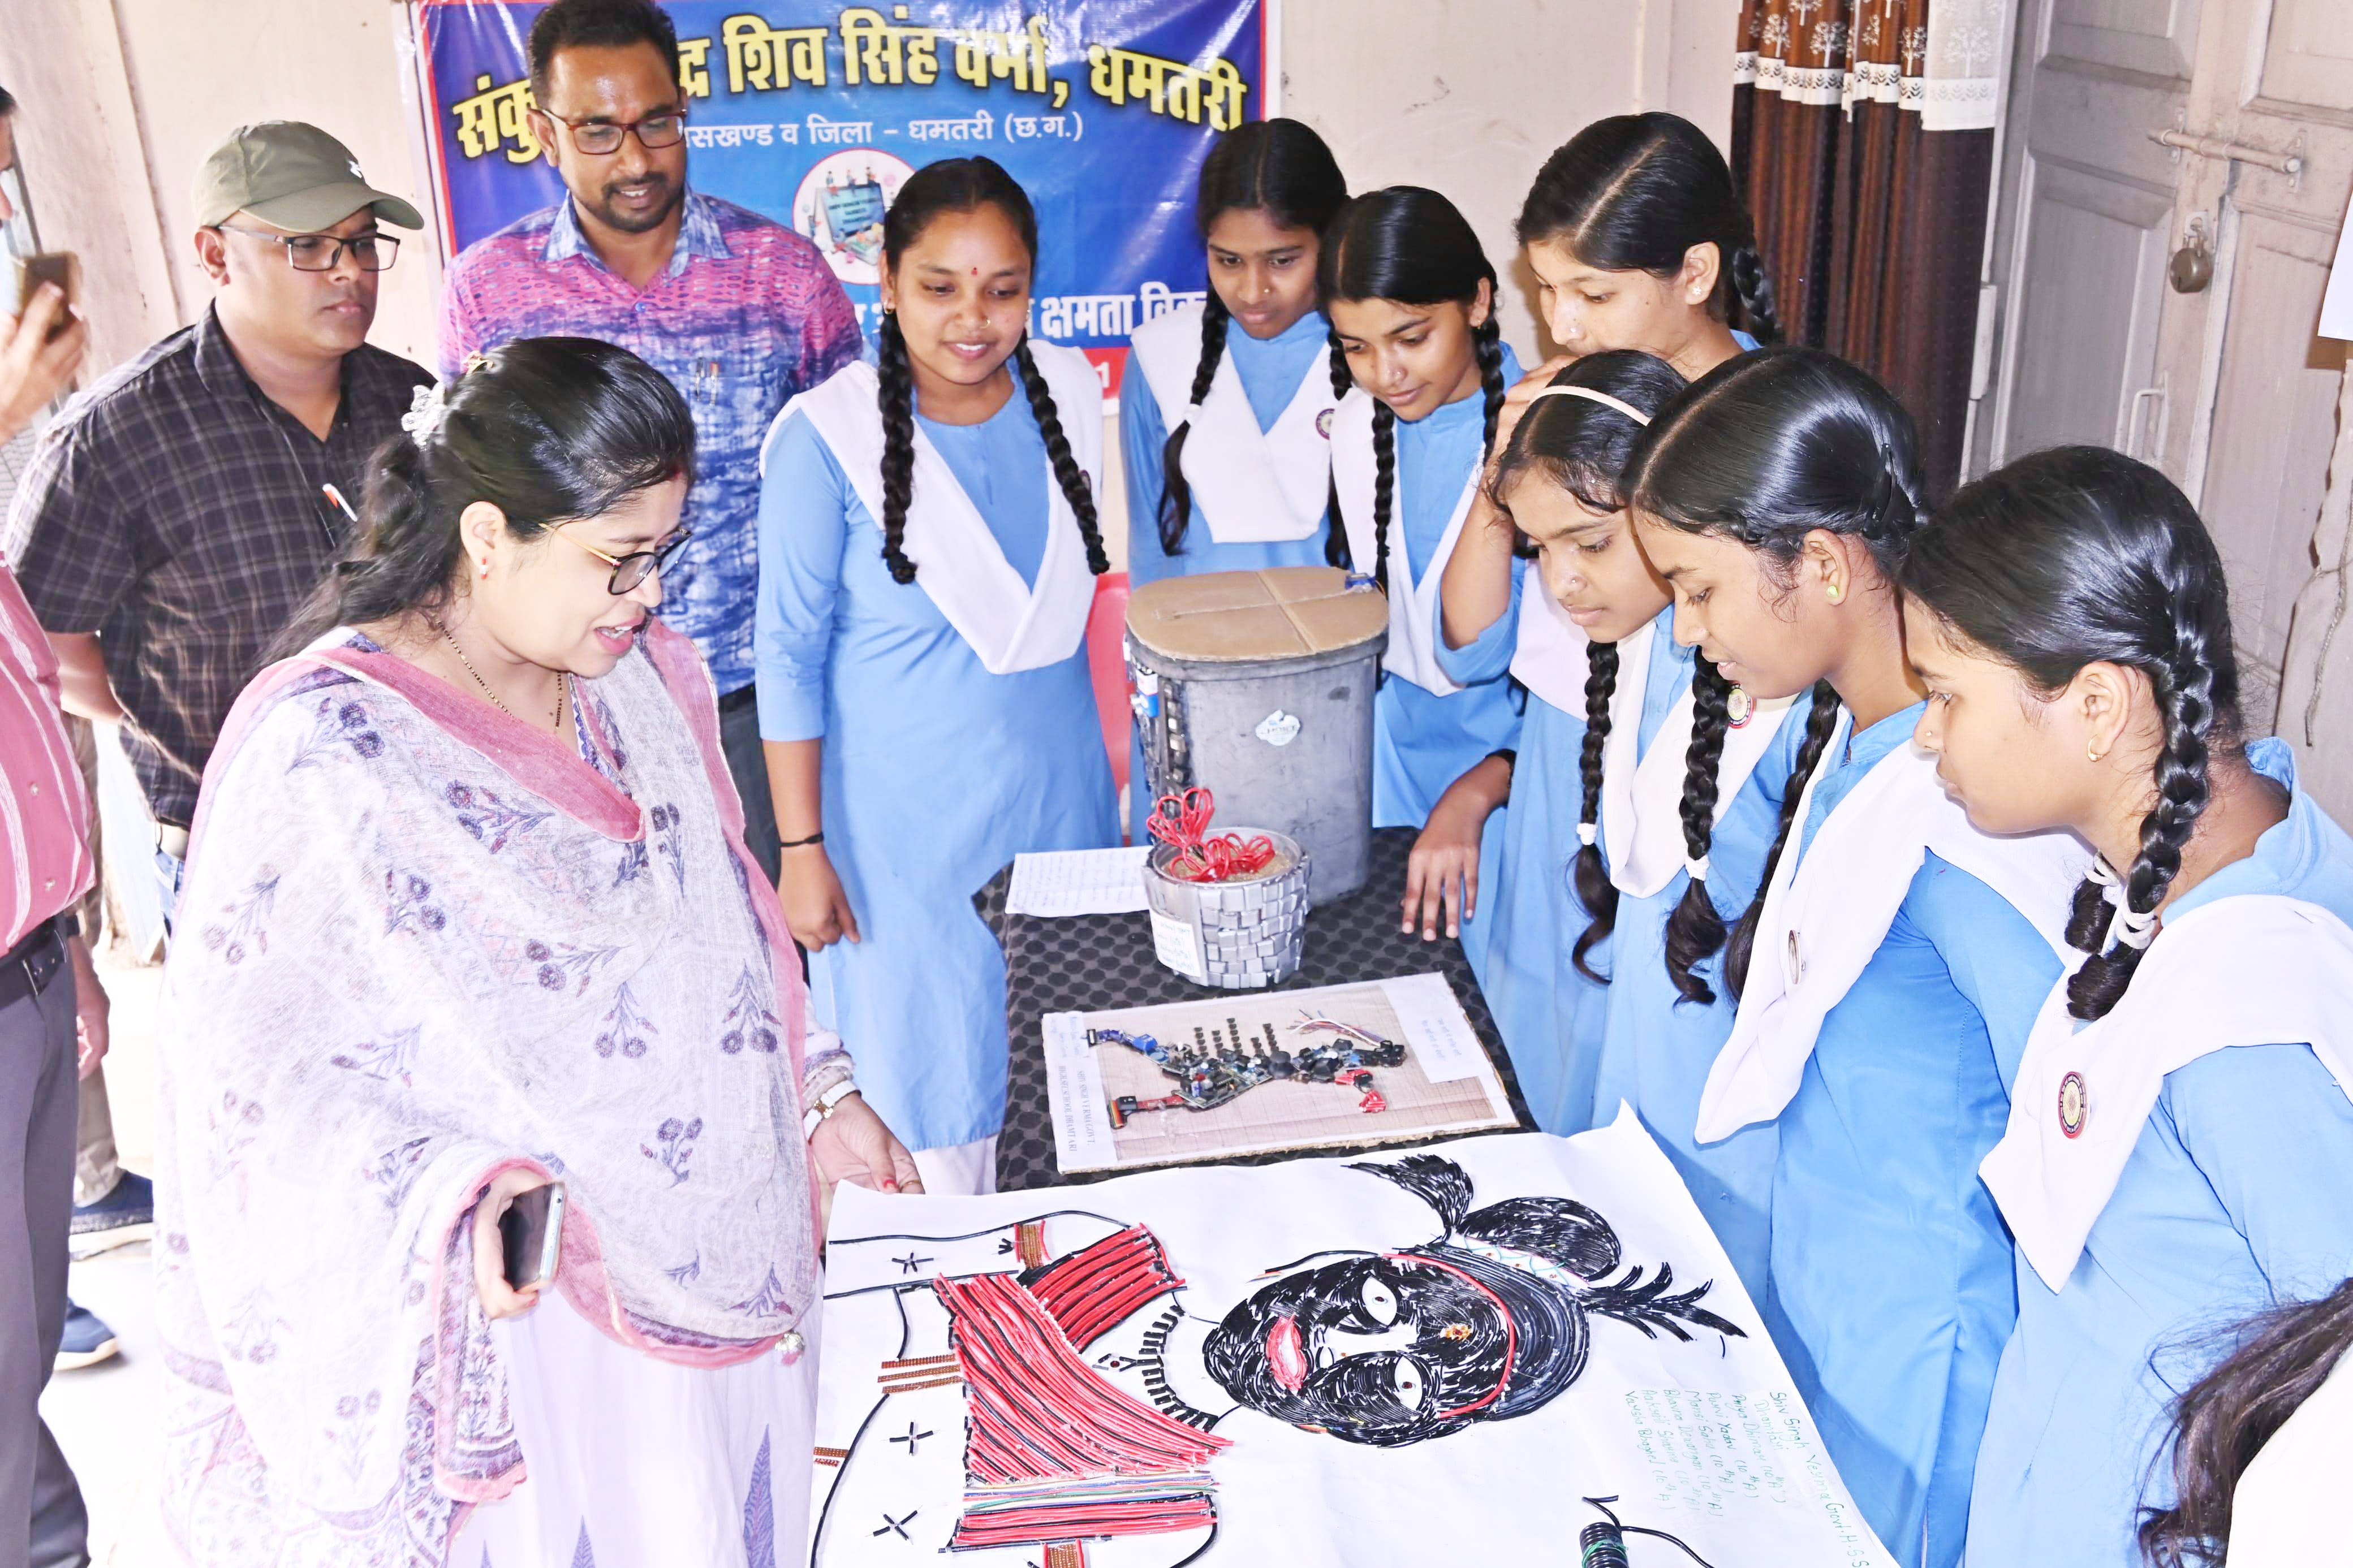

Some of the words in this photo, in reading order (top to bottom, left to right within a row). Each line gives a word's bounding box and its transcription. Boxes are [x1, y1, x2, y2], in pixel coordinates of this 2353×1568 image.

[453, 74, 542, 163] संकु
[722, 14, 828, 93] शिव
[840, 5, 939, 85] सिंह
[1087, 44, 1247, 132] धमतरी
[779, 123, 799, 145] व
[807, 113, 873, 145] जिला
[908, 109, 994, 141] धमतरी
[1004, 111, 1084, 143] (छ.ग.)
[1040, 294, 1135, 339] क्षमता
[1077, 1070, 1086, 1082] SHIV
[1079, 1083, 1089, 1099] SINGH
[1717, 1423, 1736, 1450] Yadav
[1769, 1392, 1789, 1414] Shiv
[1779, 1418, 1809, 1449] Singh
